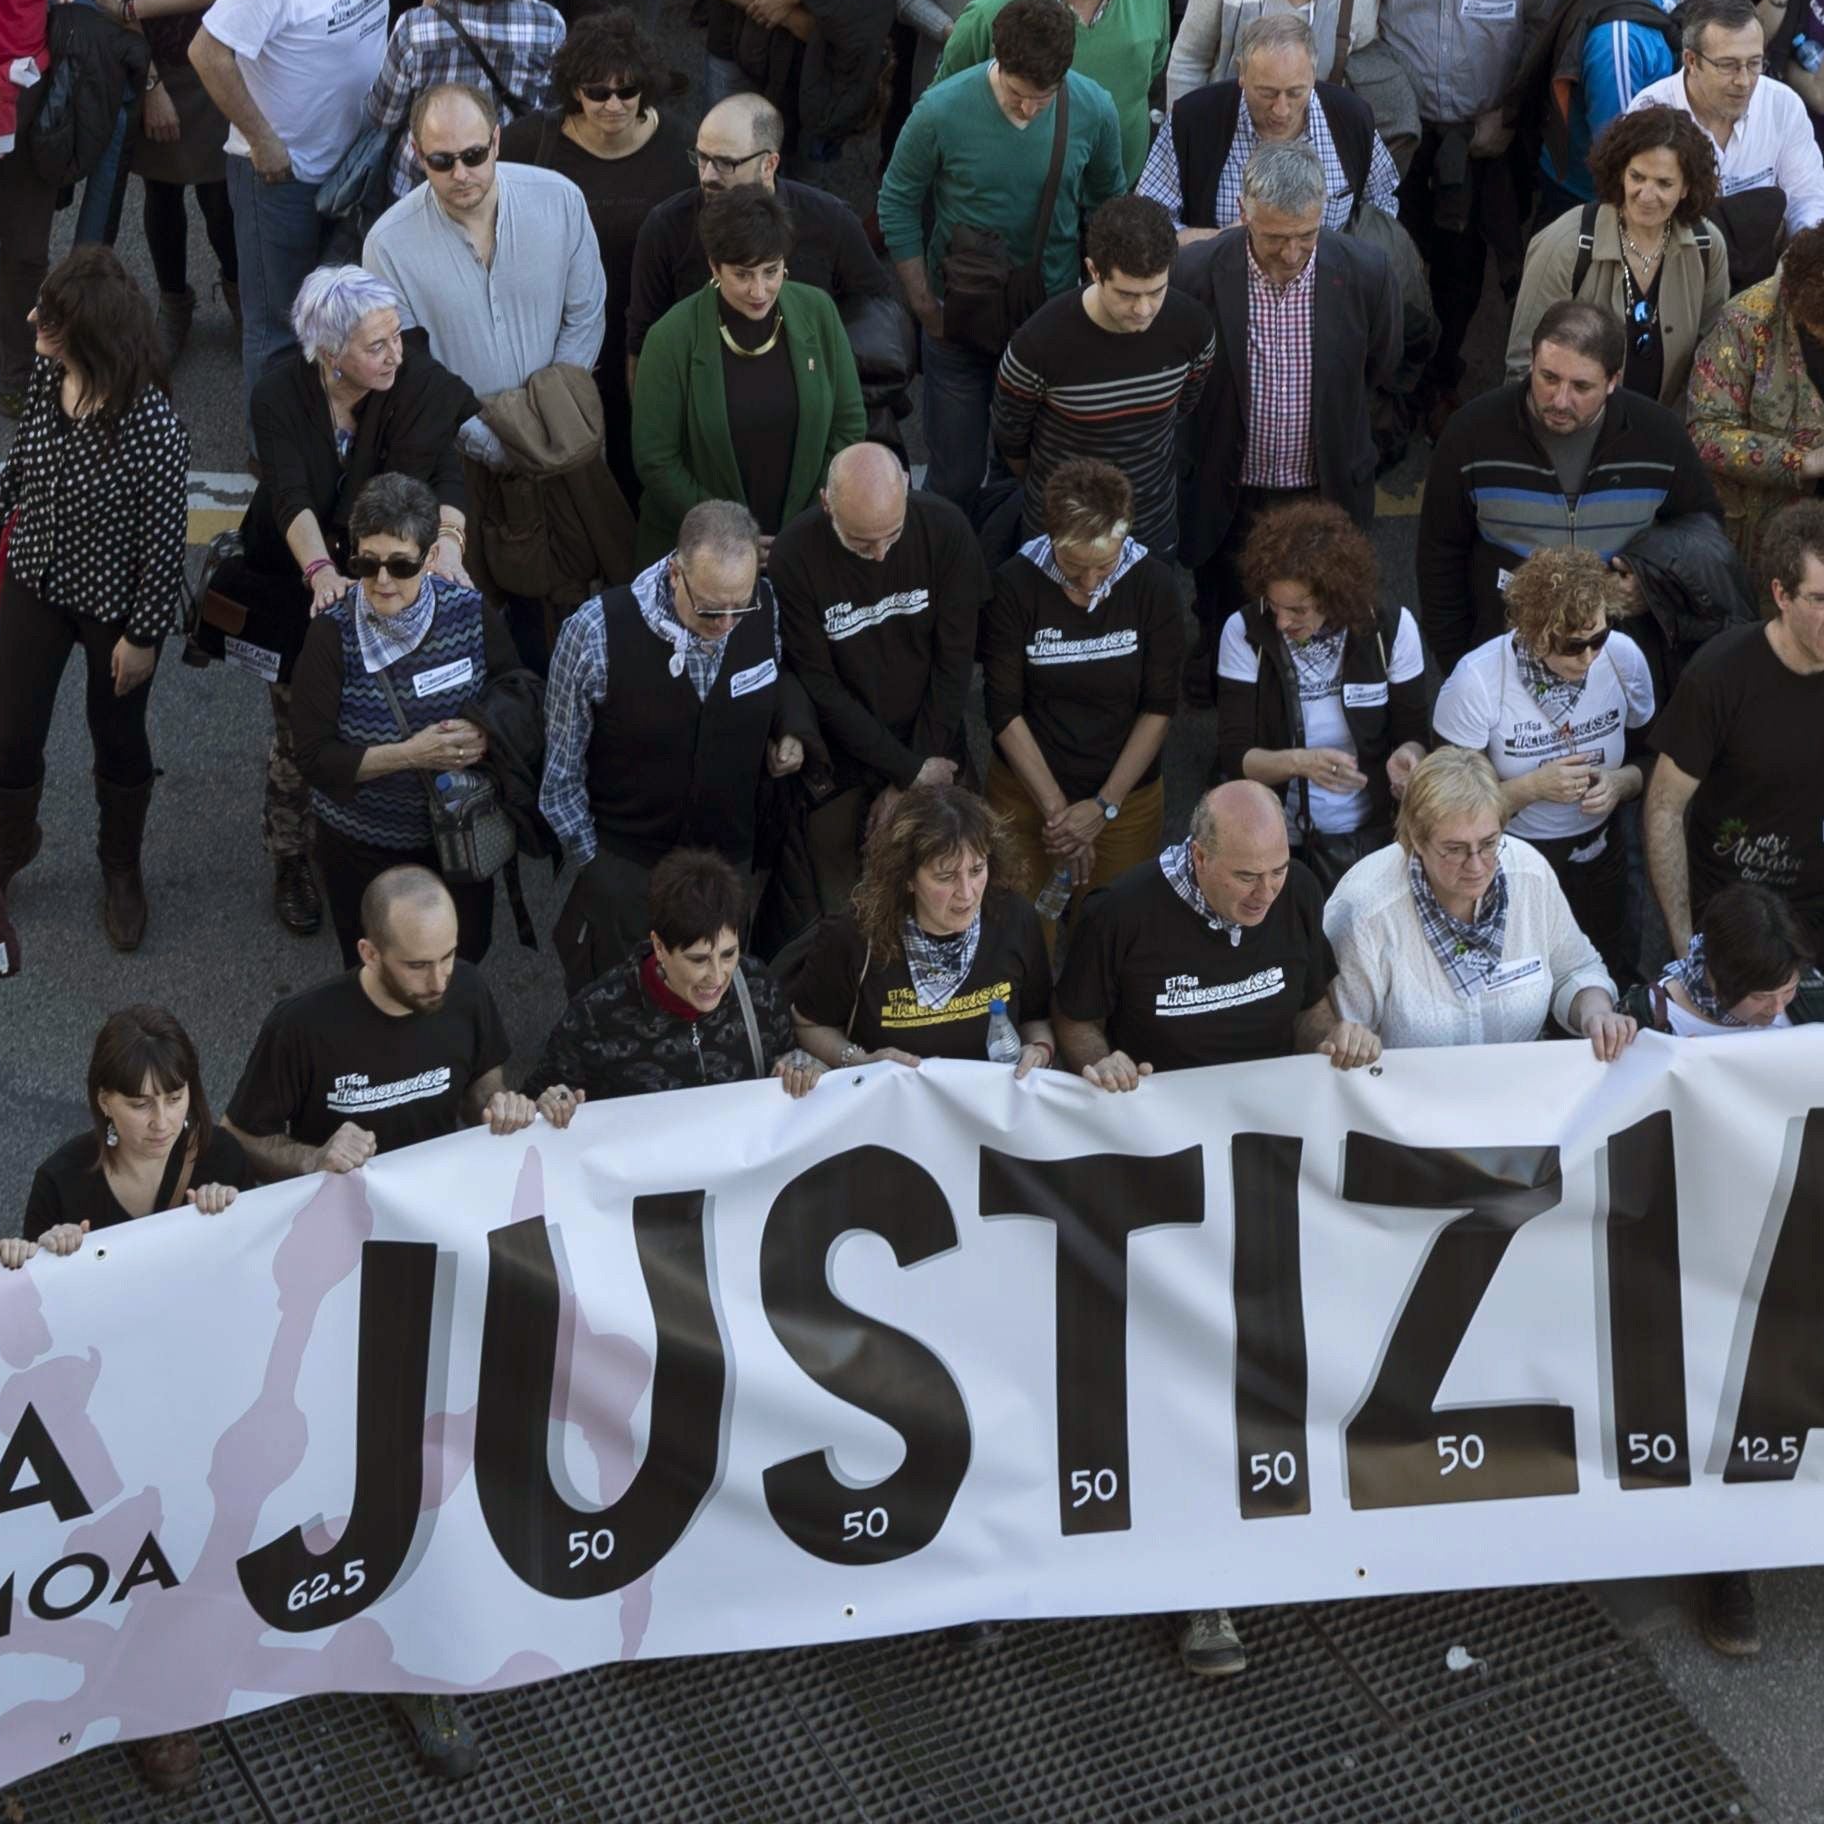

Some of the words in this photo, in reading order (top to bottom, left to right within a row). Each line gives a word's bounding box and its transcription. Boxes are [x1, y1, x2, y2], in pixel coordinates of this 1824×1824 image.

[1436, 1433, 1485, 1476] 50
[1627, 1432, 1677, 1464] 50
[1737, 1435, 1800, 1466] 12.5
[1070, 1468, 1118, 1509] 50
[1249, 1450, 1297, 1492] 50
[841, 1506, 890, 1541] 50
[567, 1528, 615, 1570] 50
[286, 1559, 366, 1613] 62.5
